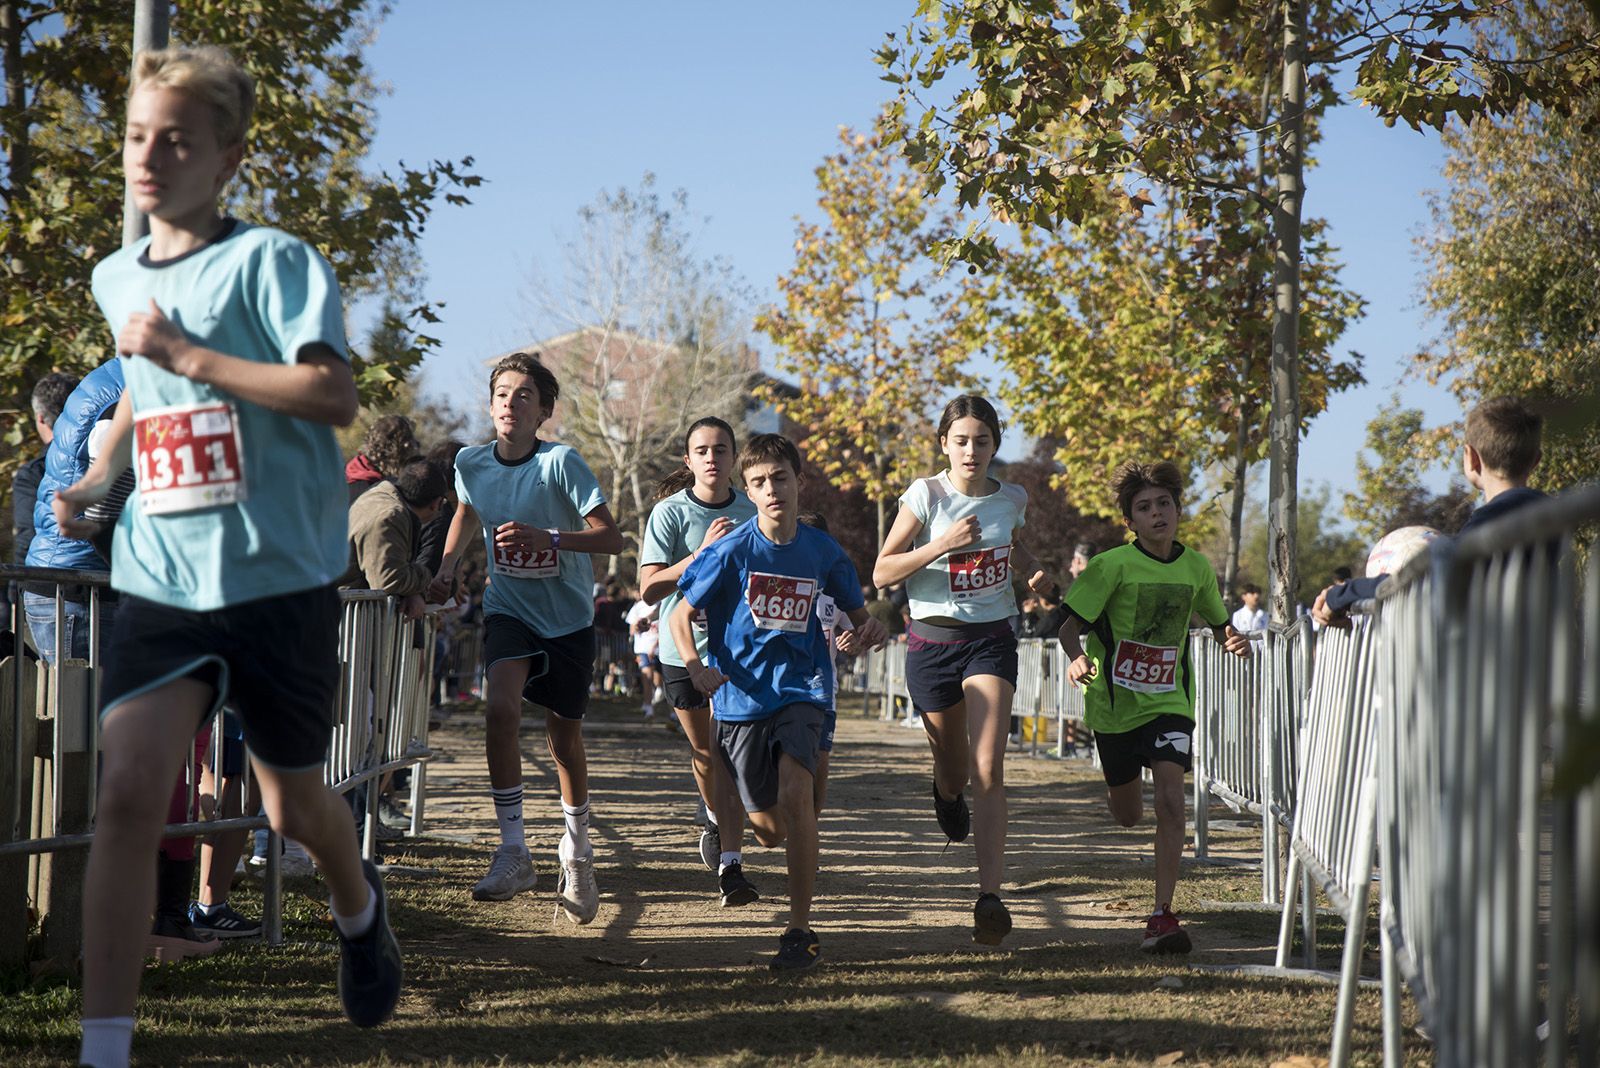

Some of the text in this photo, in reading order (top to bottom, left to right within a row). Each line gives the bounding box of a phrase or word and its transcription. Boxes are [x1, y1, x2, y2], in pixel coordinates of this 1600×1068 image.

[139, 441, 235, 490] 1311
[498, 547, 555, 567] 1322
[954, 562, 1006, 590] 4683
[751, 594, 808, 620] 4680
[1118, 658, 1174, 683] 4597
